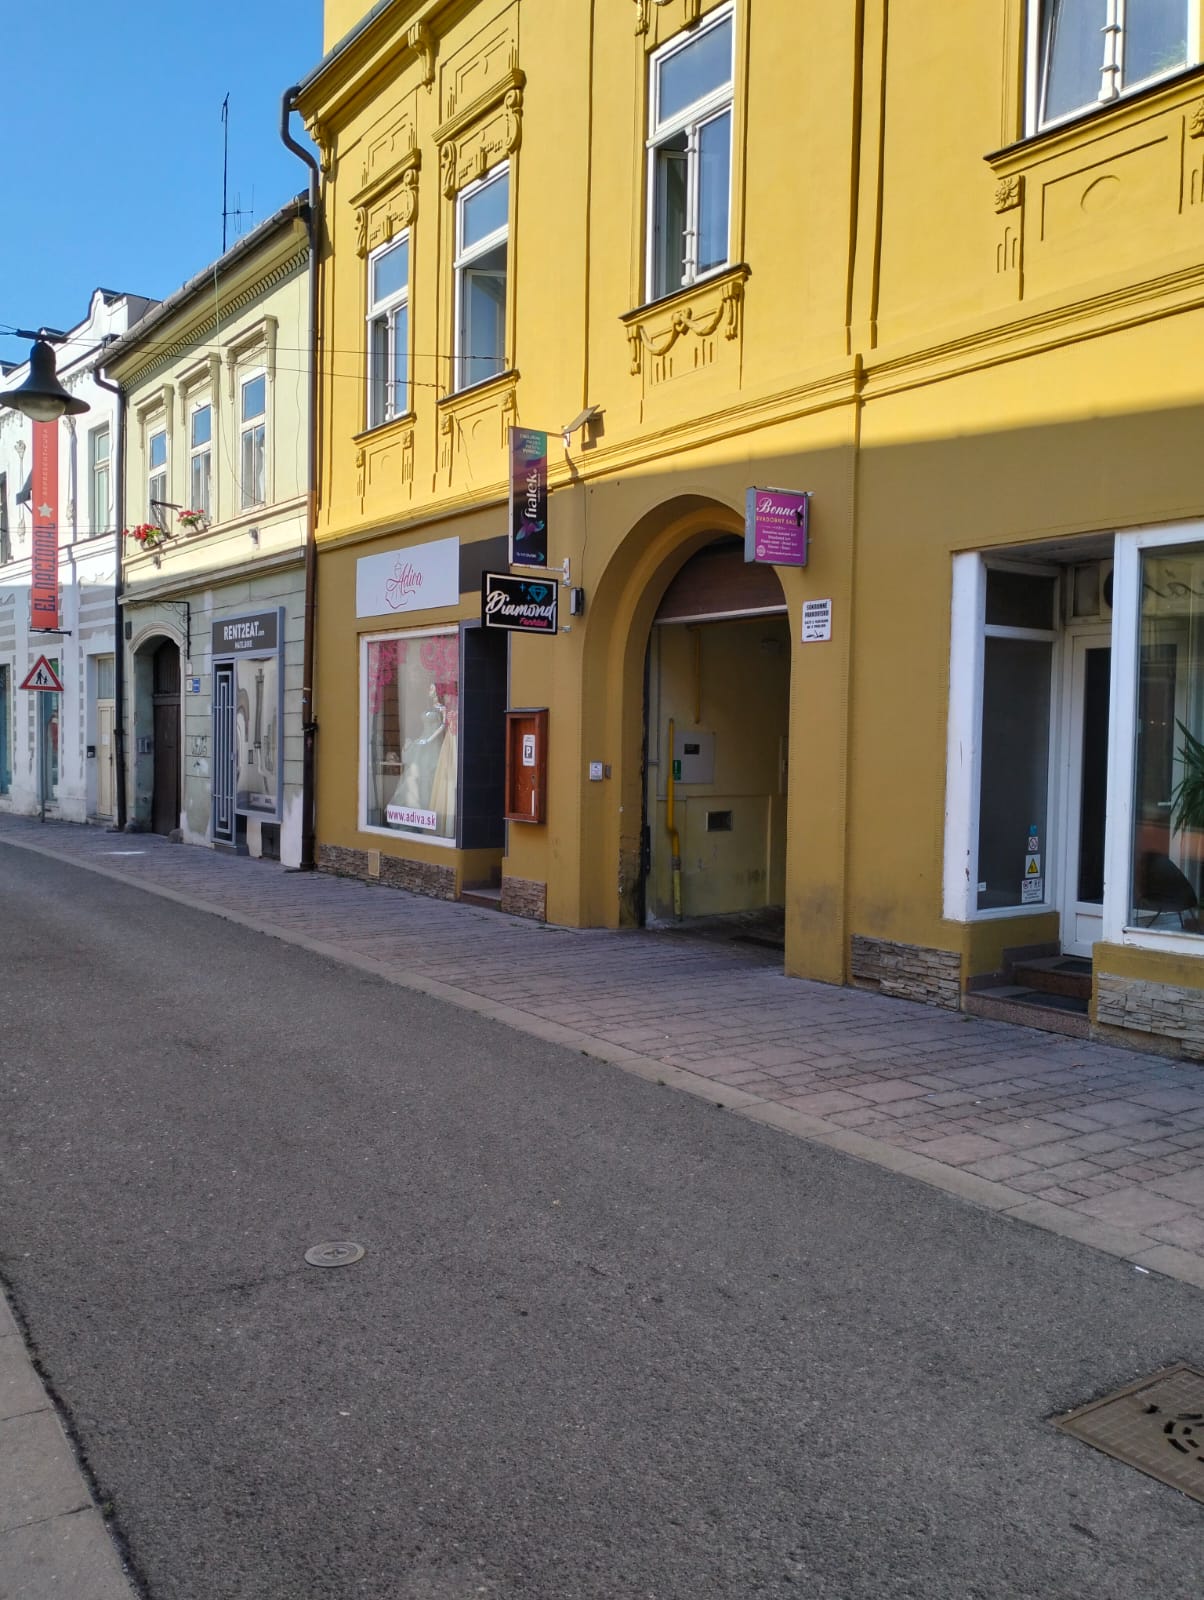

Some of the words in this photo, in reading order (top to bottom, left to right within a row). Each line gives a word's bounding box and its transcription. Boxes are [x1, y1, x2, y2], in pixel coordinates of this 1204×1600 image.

[33, 522, 56, 592] NACIONAL
[33, 595, 56, 612] EL
[485, 590, 557, 621] Diamond
[387, 809, 436, 826] www.adiva.sk
